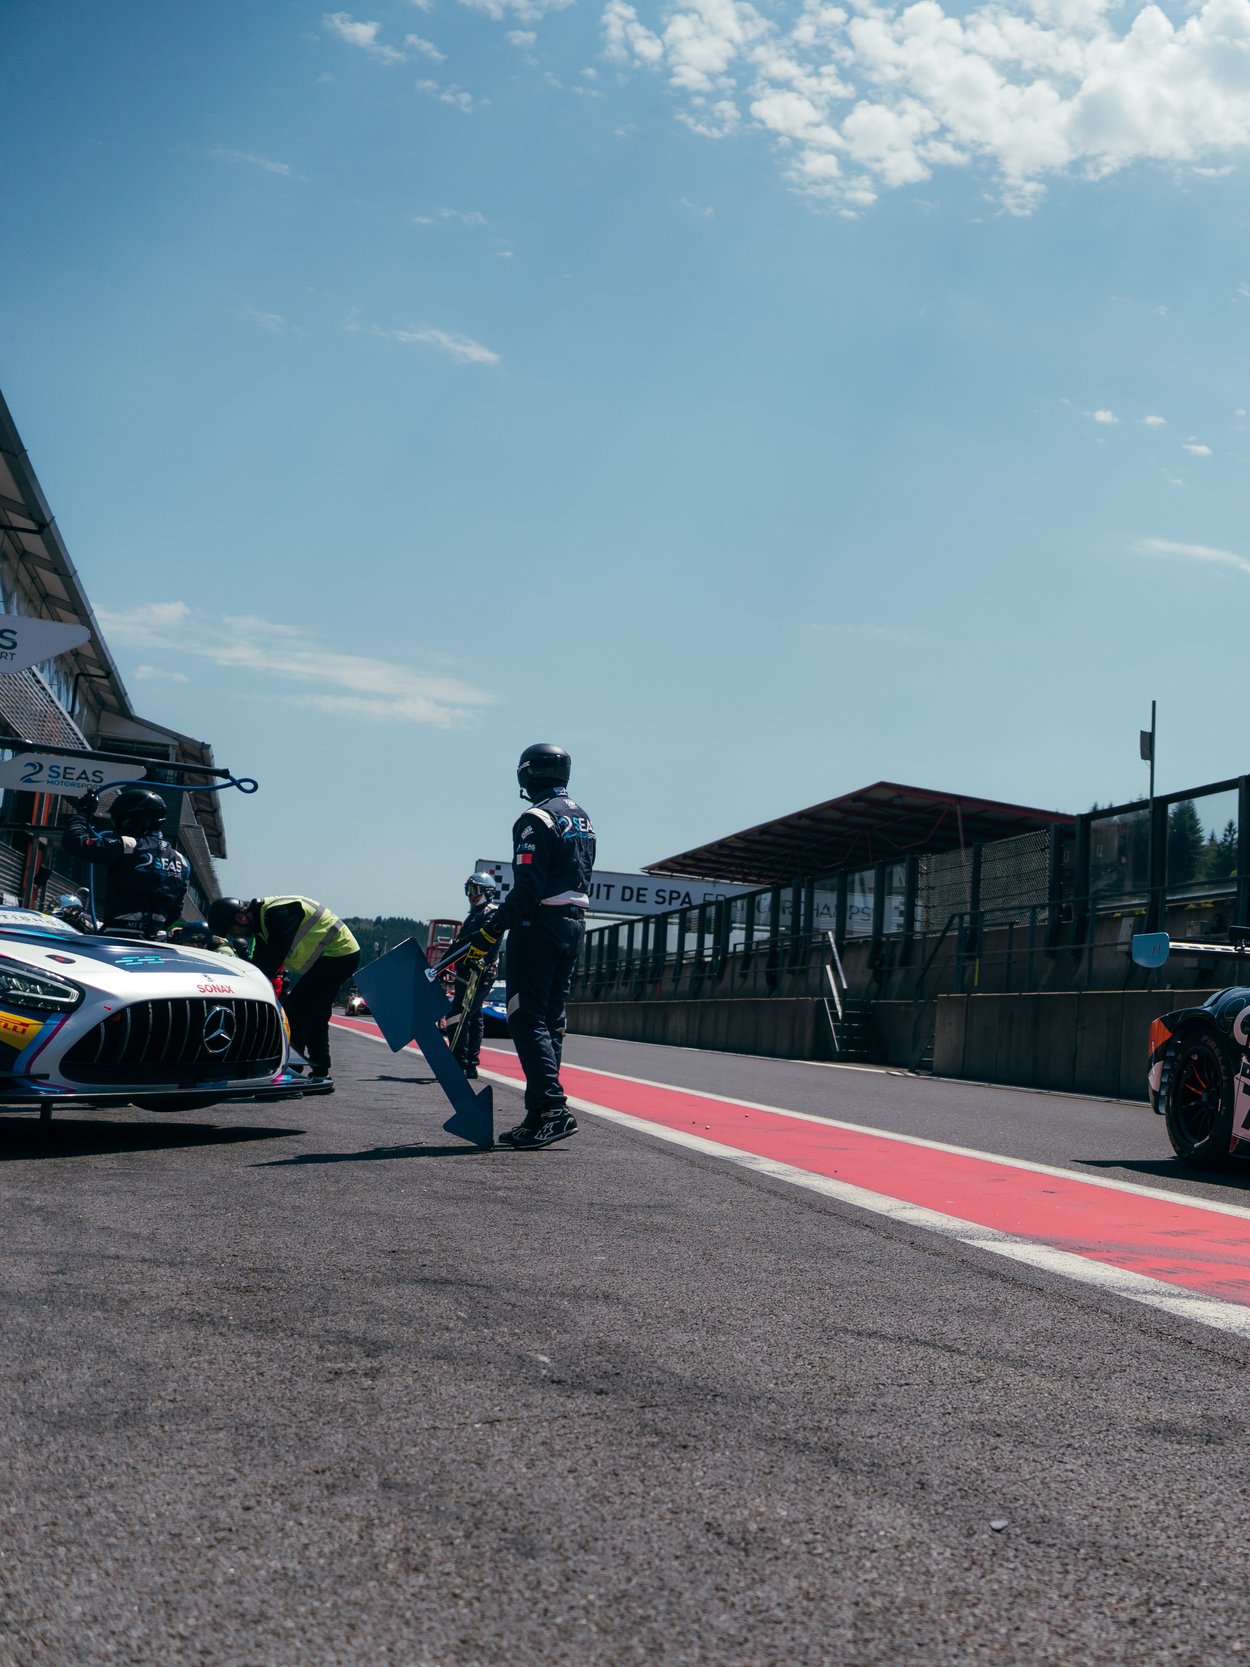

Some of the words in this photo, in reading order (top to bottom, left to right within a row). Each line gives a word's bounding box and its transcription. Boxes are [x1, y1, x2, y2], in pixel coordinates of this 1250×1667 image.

[47, 765, 104, 783] SEAS
[572, 815, 595, 834] SEA
[154, 857, 182, 873] SEAS
[621, 885, 648, 904] DE
[654, 888, 693, 907] SPA
[196, 984, 235, 993] SONAX
